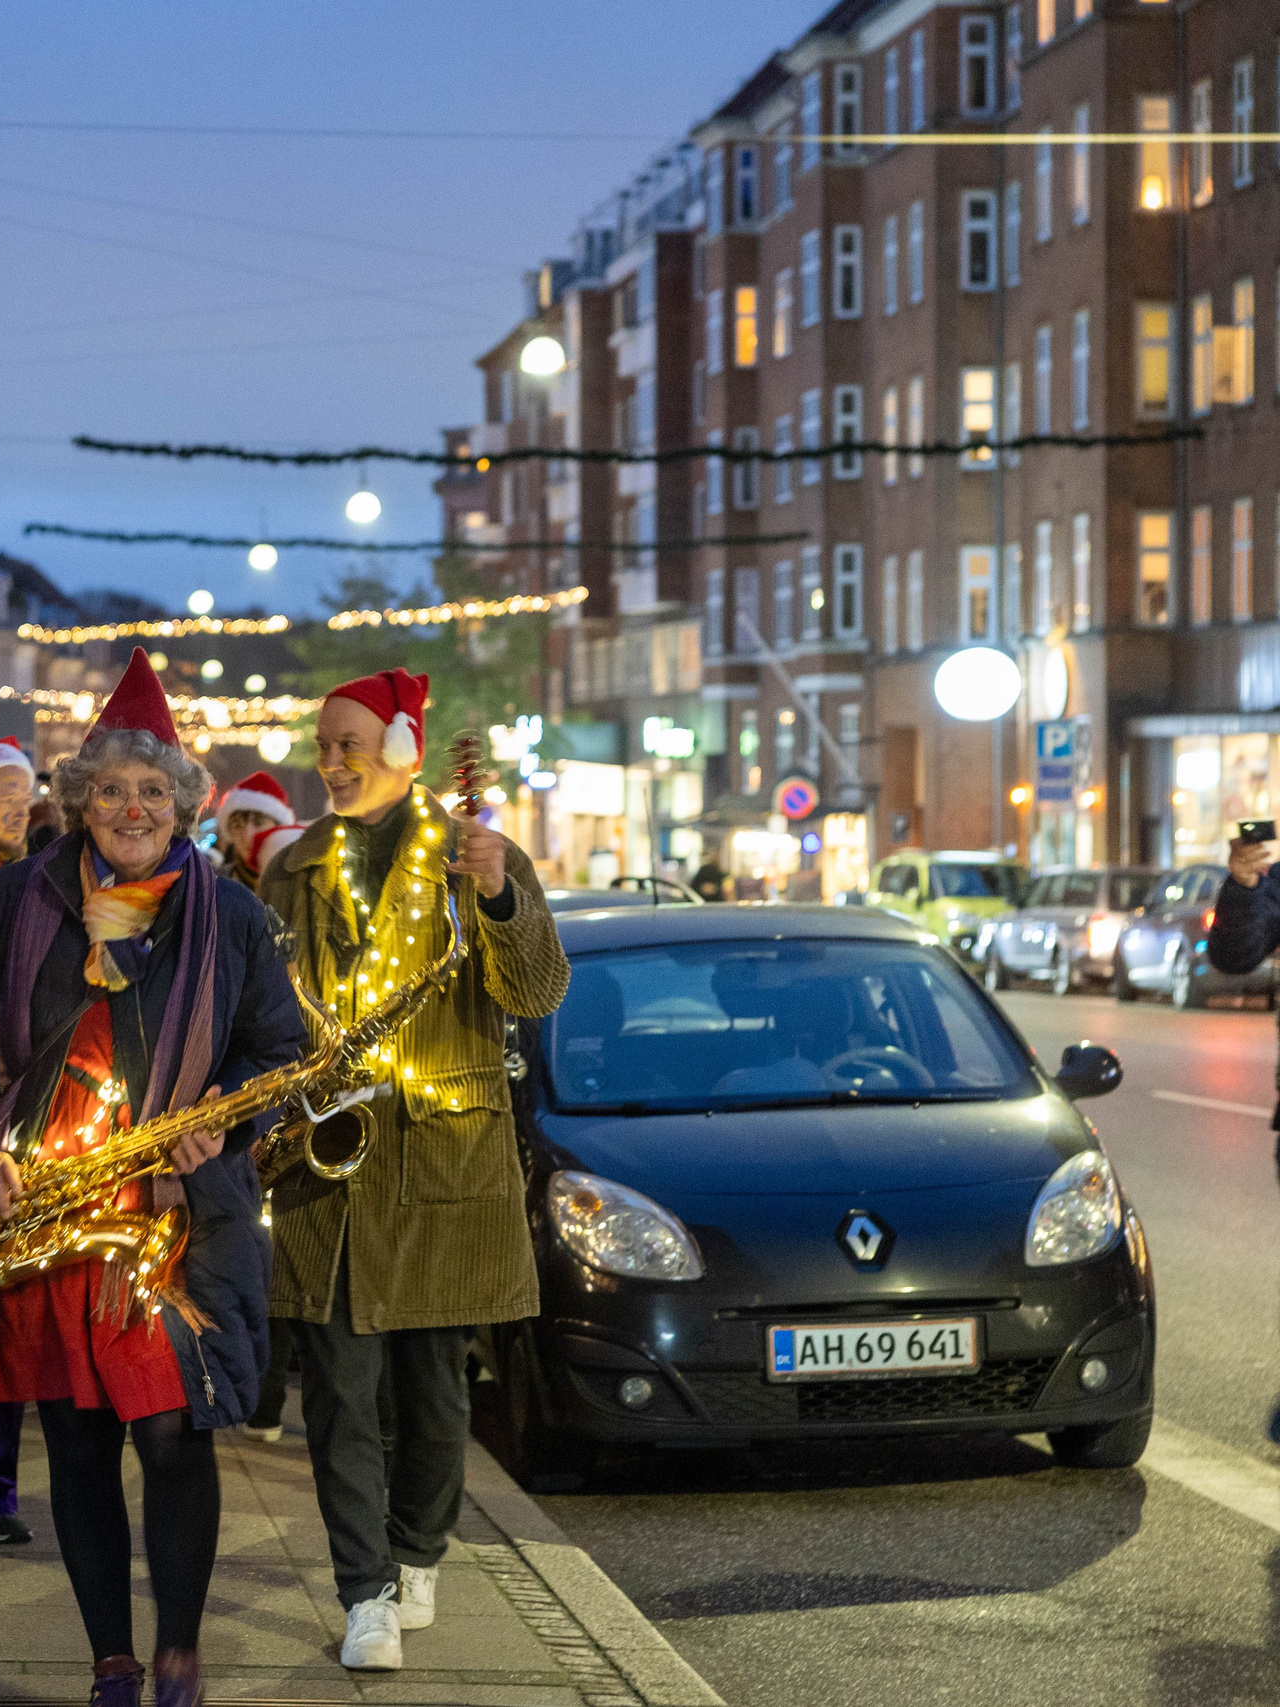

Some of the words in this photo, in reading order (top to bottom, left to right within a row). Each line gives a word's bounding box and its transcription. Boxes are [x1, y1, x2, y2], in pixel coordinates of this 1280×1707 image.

[1045, 726, 1067, 757] P
[777, 1355, 790, 1365] DK
[799, 1334, 844, 1365] AH
[855, 1332, 896, 1364] 69
[907, 1329, 965, 1361] 641
